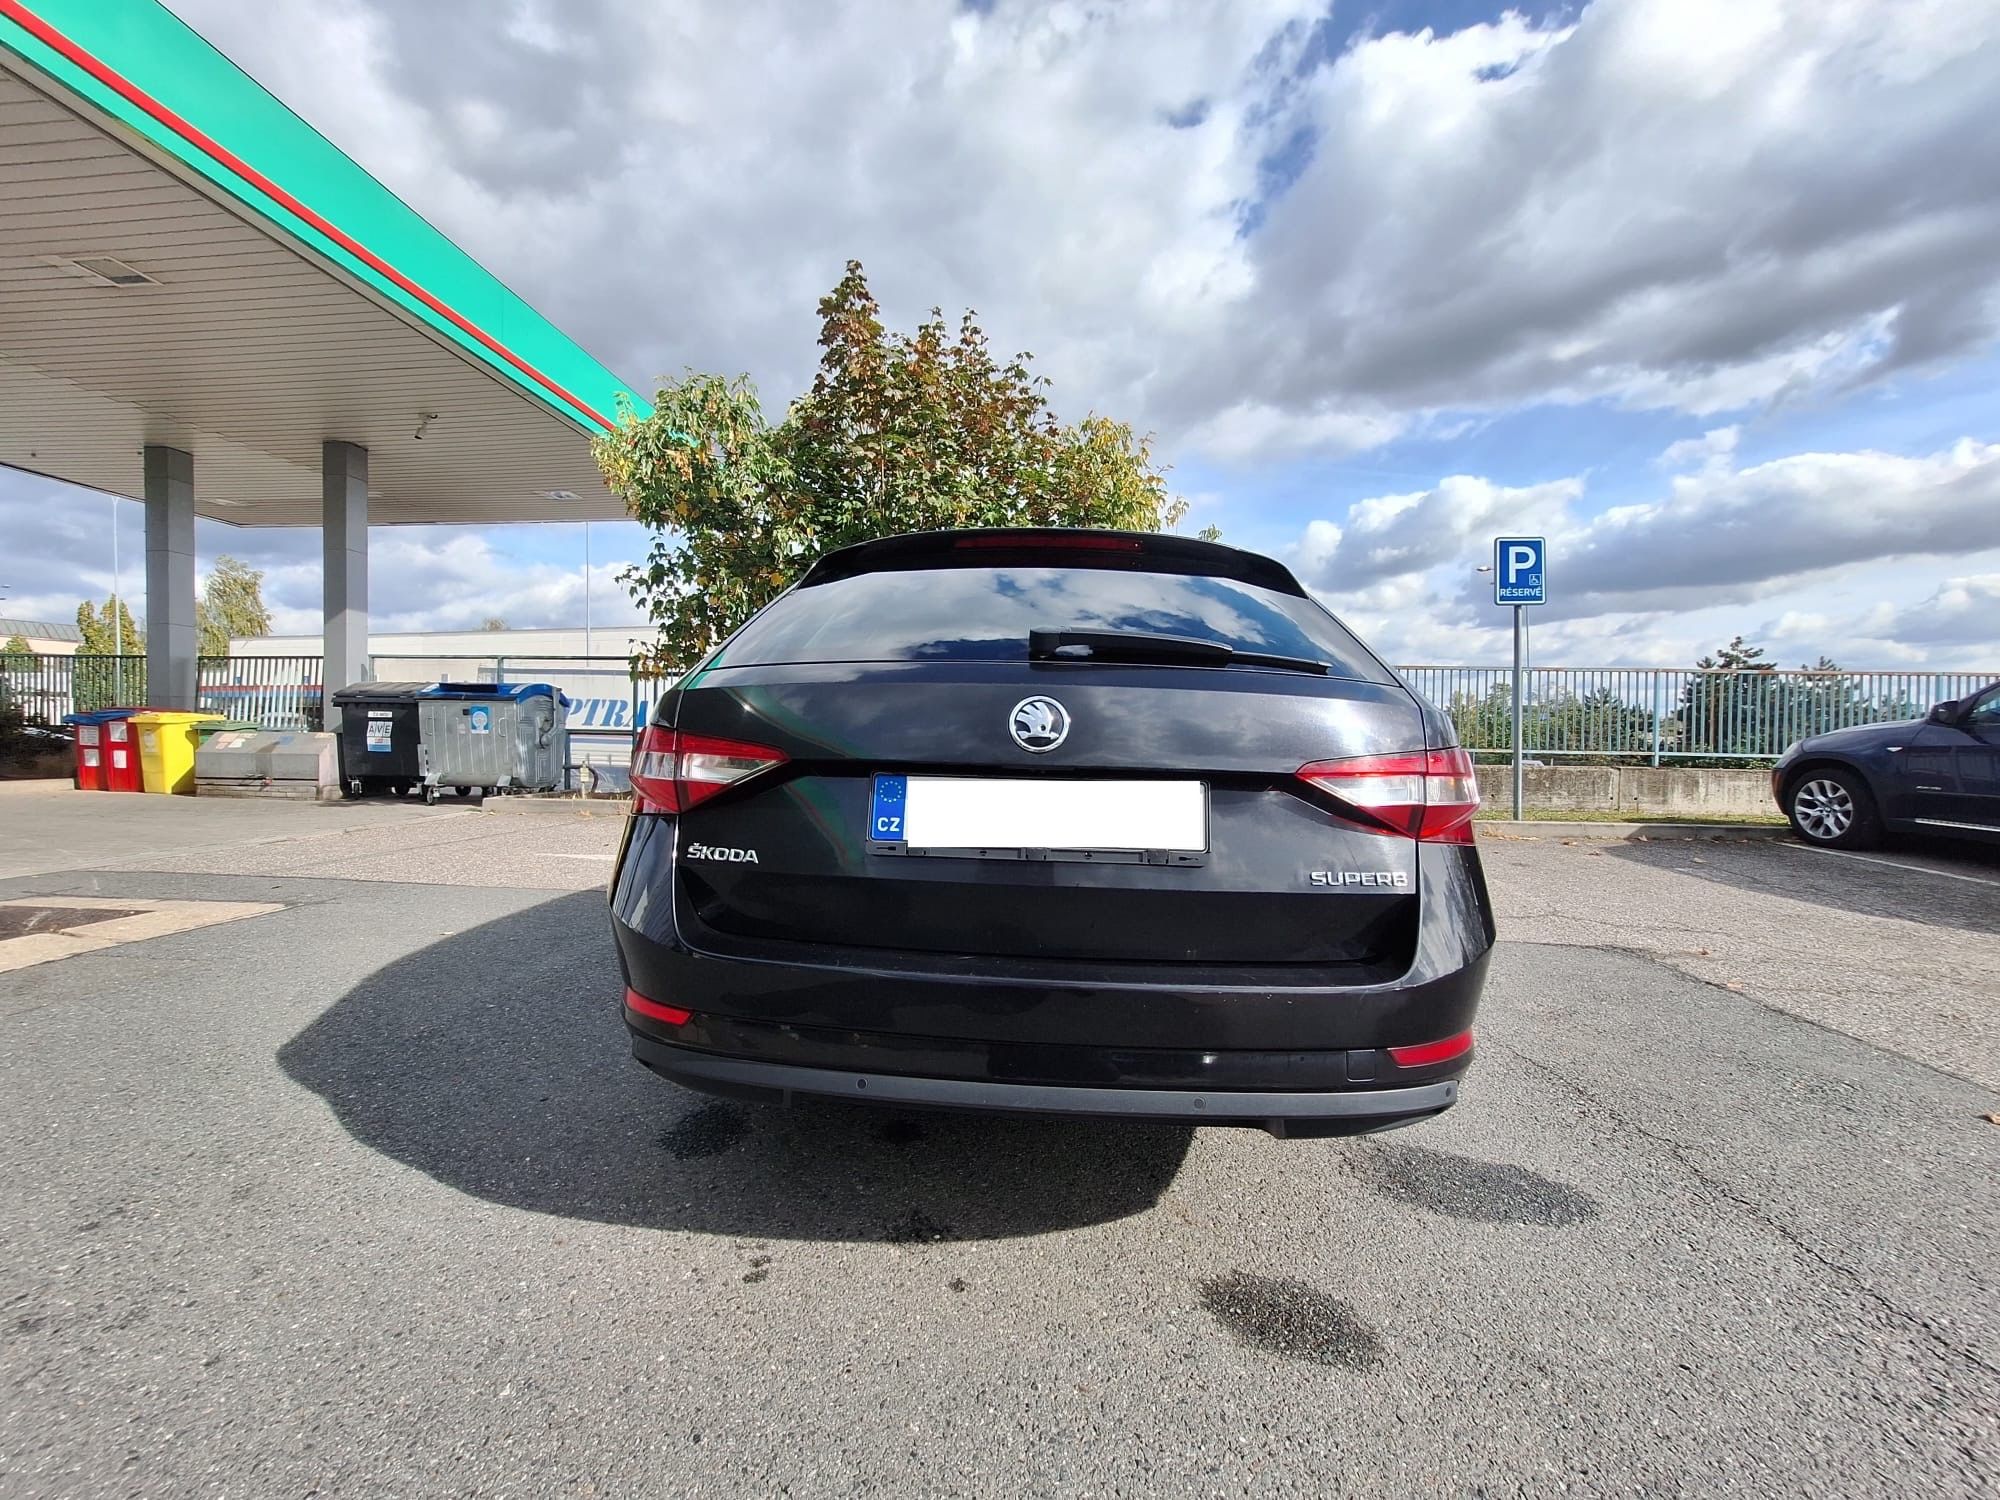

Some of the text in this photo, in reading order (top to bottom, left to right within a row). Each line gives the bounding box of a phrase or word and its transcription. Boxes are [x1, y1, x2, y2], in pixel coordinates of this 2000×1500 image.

[1509, 546, 1536, 583] P
[1500, 586, 1542, 597] RÉSERVÉ
[368, 723, 391, 735] AVE
[877, 817, 900, 832] CZ
[686, 842, 759, 864] ŠKODA
[1310, 871, 1408, 886] SUPERB
